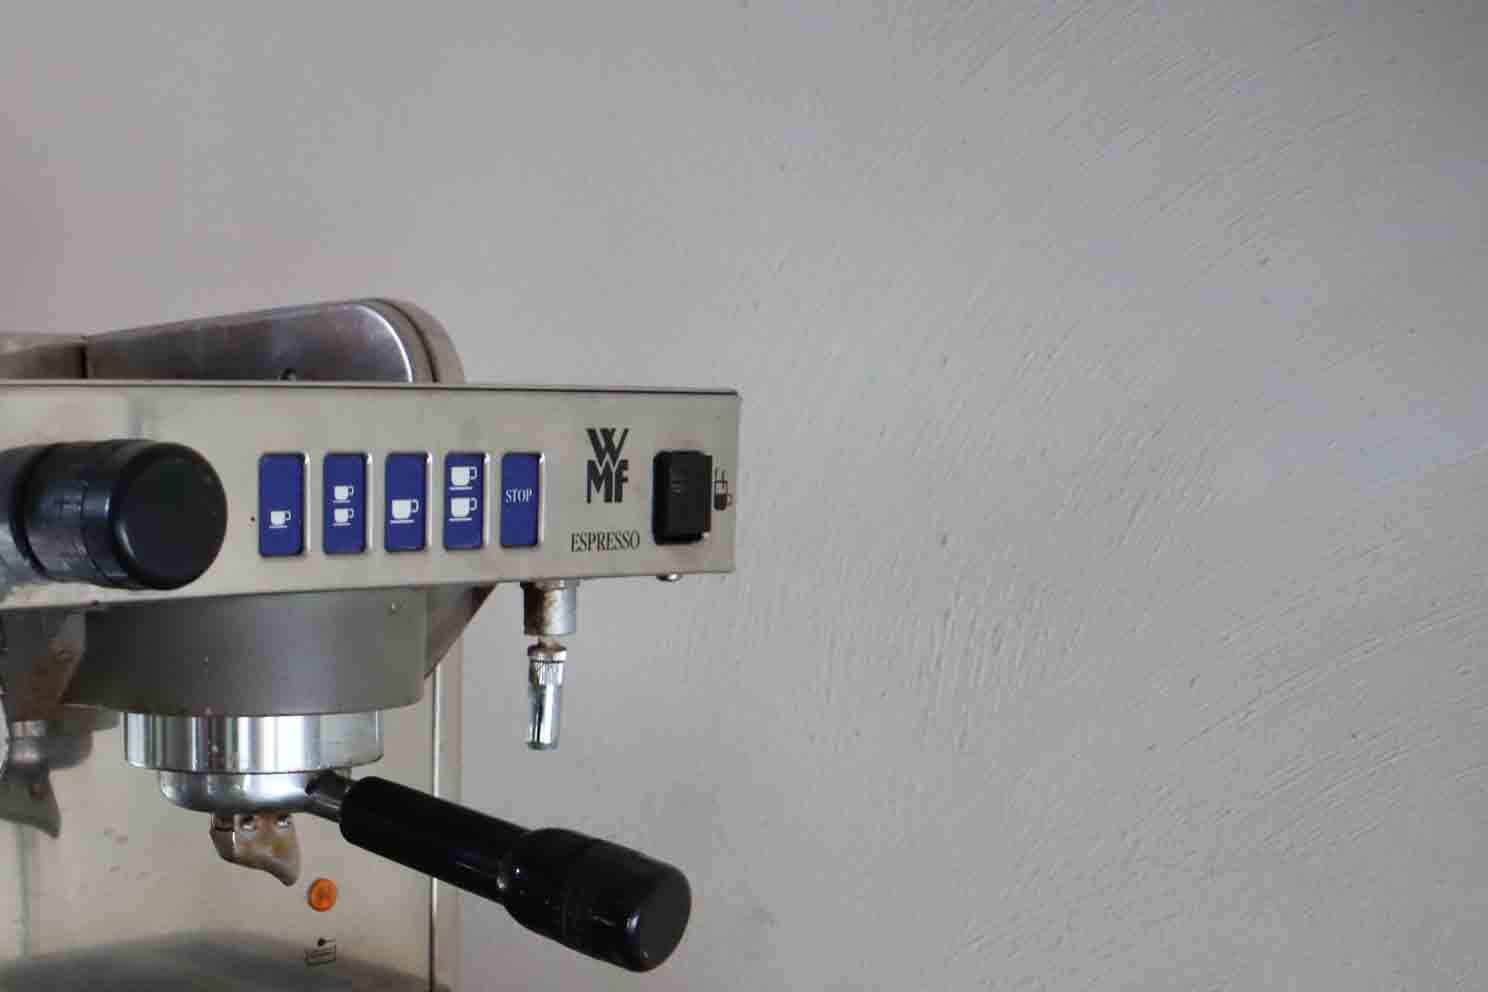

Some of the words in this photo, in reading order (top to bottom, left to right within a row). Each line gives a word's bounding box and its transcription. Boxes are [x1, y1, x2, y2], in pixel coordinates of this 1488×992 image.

[585, 427, 630, 504] WMF
[504, 488, 533, 504] STOP
[570, 529, 641, 553] ESPRESSO
